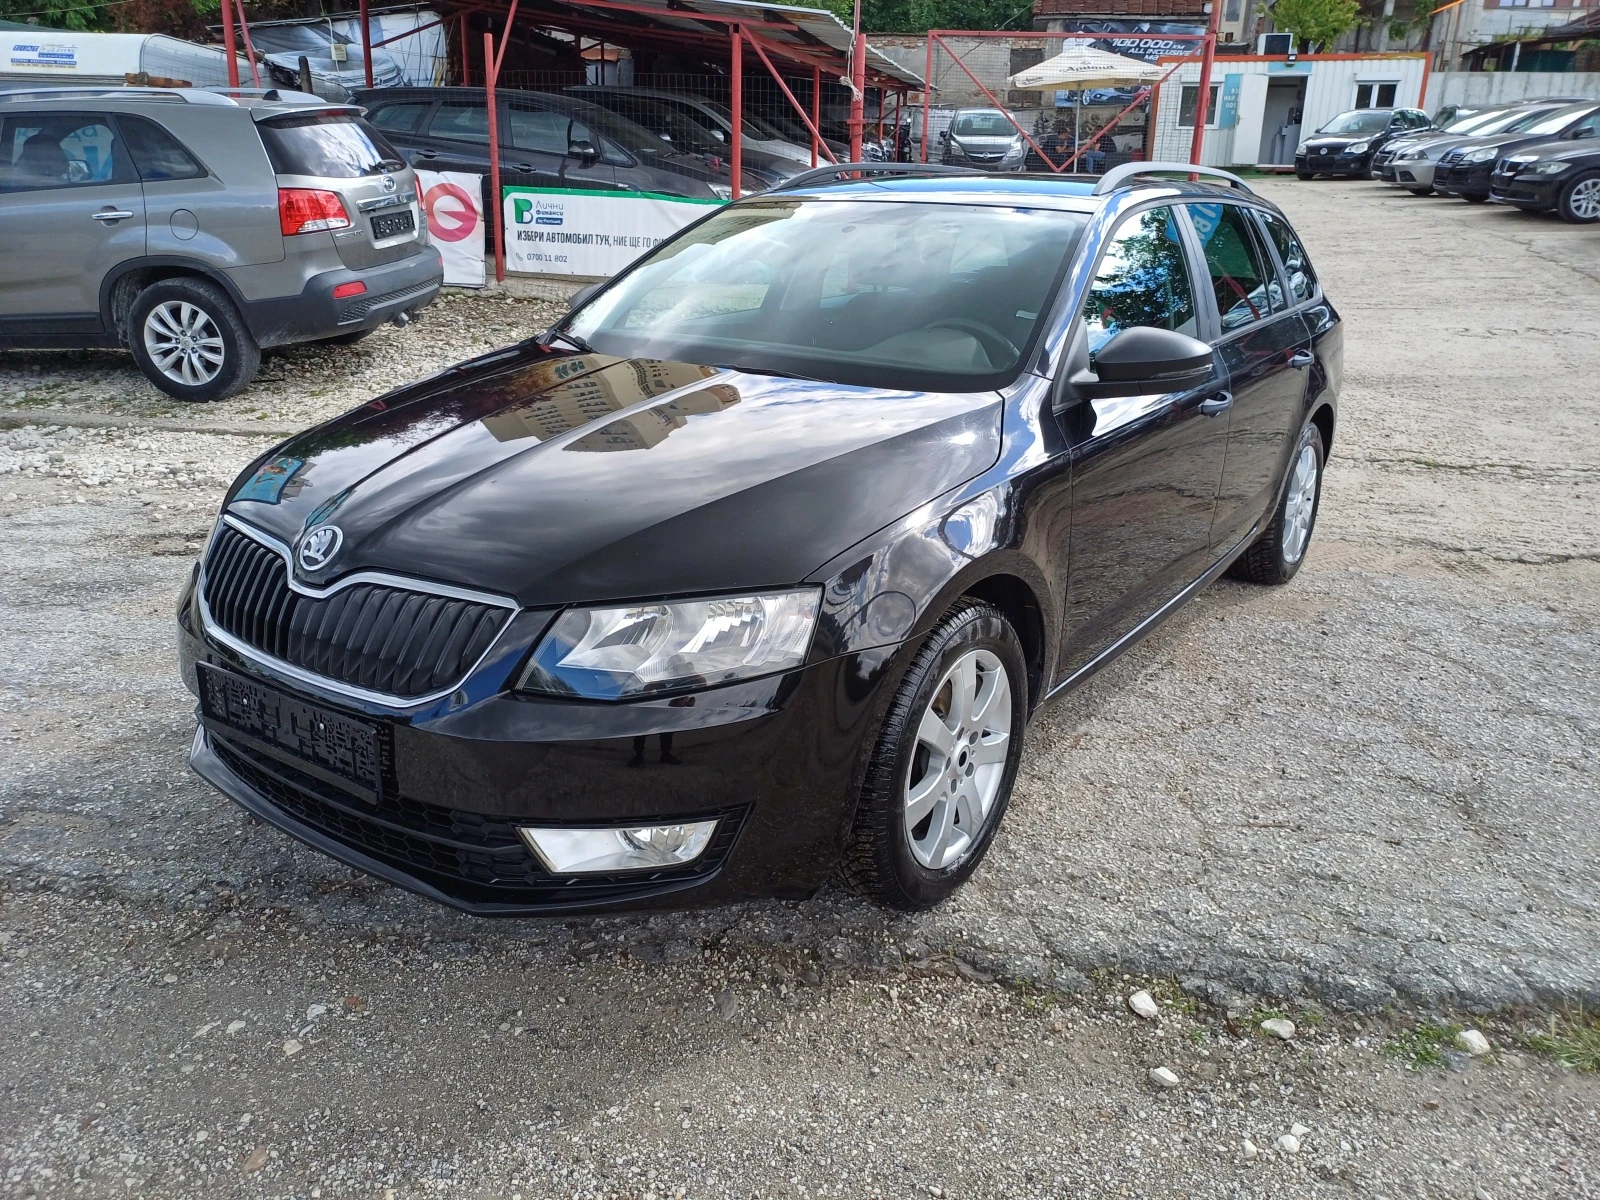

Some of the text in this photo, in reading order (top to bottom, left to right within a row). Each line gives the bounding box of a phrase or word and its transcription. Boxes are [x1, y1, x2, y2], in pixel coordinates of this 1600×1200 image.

[1112, 38, 1140, 47] 100
[1139, 38, 1173, 49] 000
[1145, 48, 1194, 57] INCLUSIVE
[535, 200, 564, 211] Лични
[517, 230, 545, 243] ИЗБЕРИ
[545, 232, 594, 245] АВТОМОБИЛ
[595, 234, 612, 248] ТУК,
[612, 235, 628, 247] НИЕ
[629, 236, 641, 249] ЩЕ
[642, 237, 652, 248] ГО
[526, 253, 568, 263] 0700 11 802
